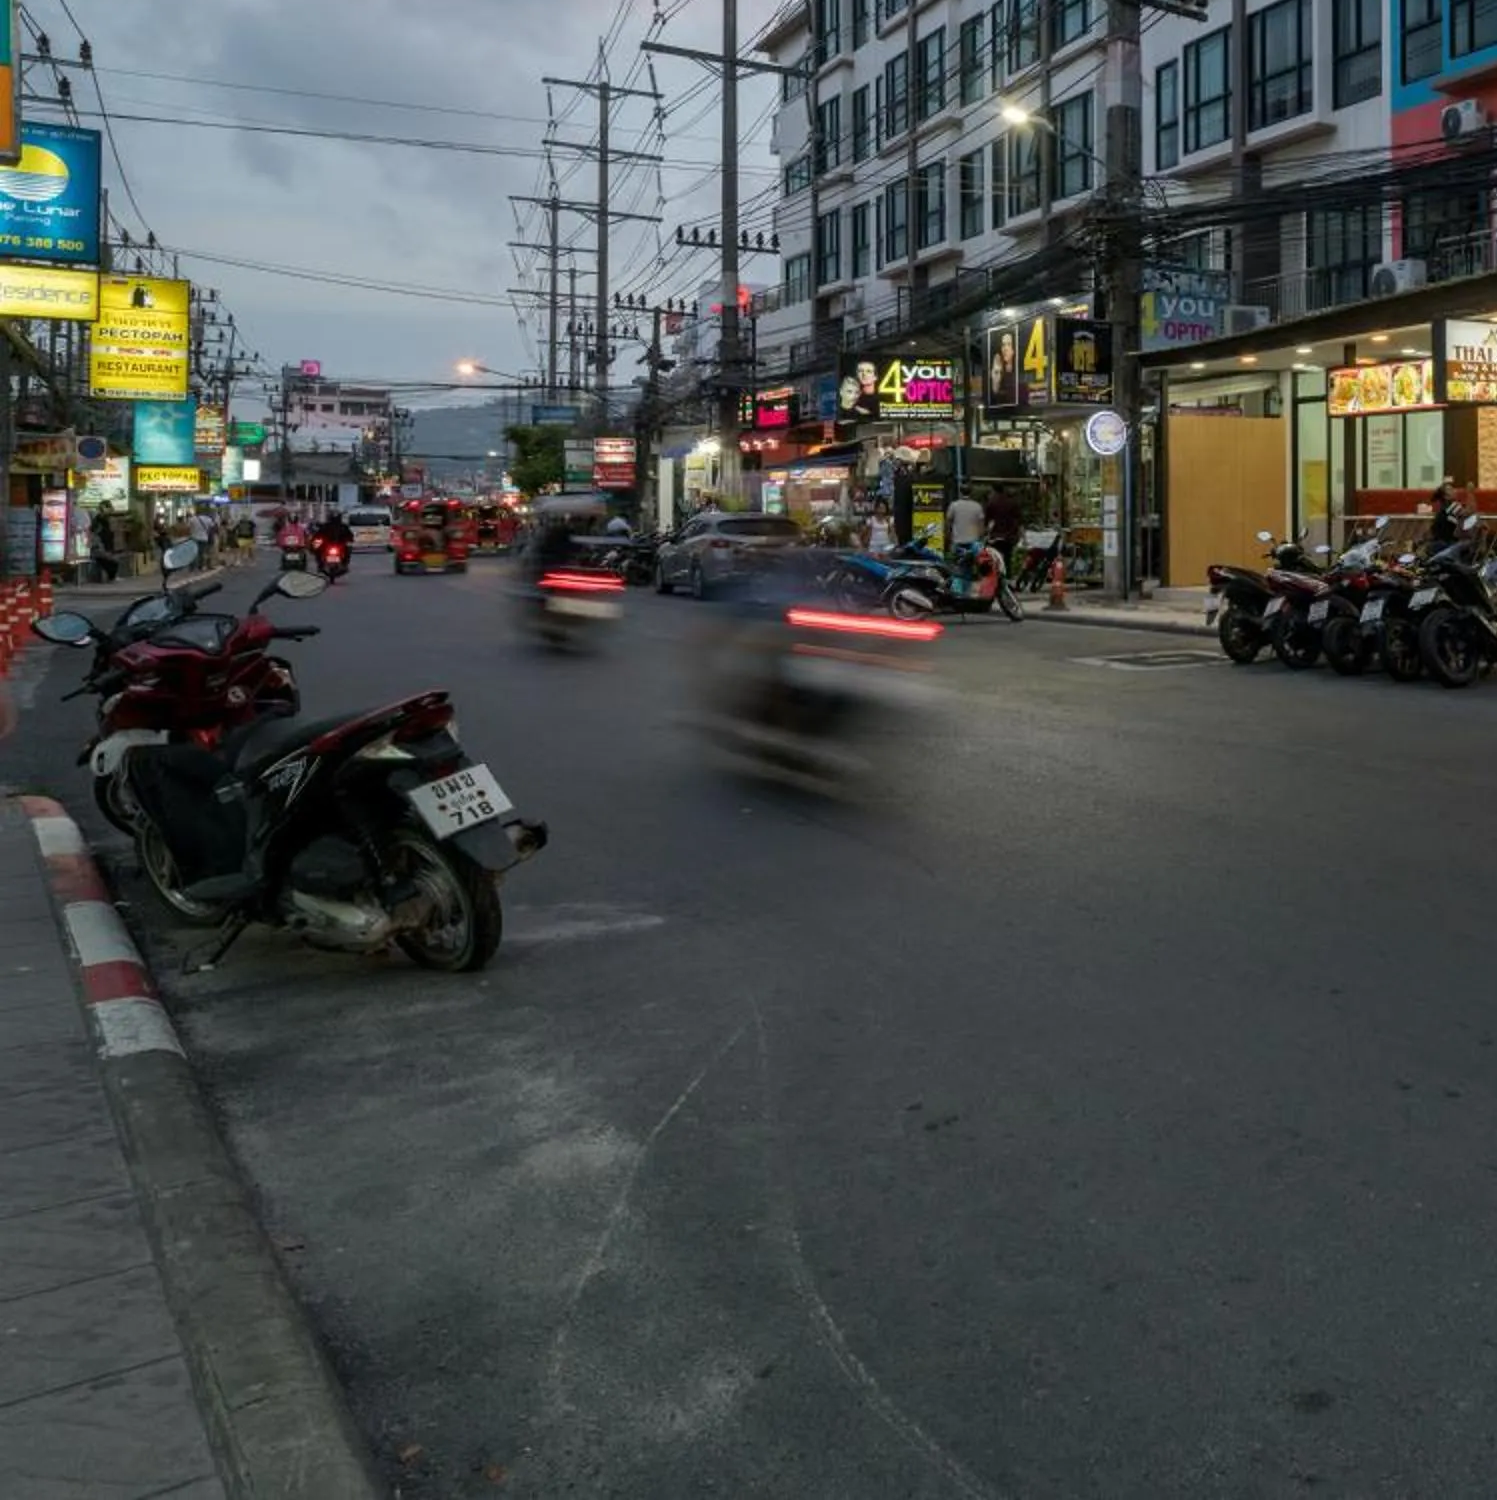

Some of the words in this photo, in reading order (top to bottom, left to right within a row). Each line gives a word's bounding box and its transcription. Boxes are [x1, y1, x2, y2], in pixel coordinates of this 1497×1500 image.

[0, 282, 91, 305] esidence
[1161, 295, 1216, 319] you
[99, 327, 183, 341] РЕСТОРАН
[1023, 315, 1048, 381] 4
[1454, 345, 1493, 362] THAI
[97, 361, 182, 374] RESTAURANT
[878, 359, 906, 403] 4
[901, 365, 952, 383] you
[906, 381, 953, 403] OPTIC
[449, 801, 495, 826] 718
